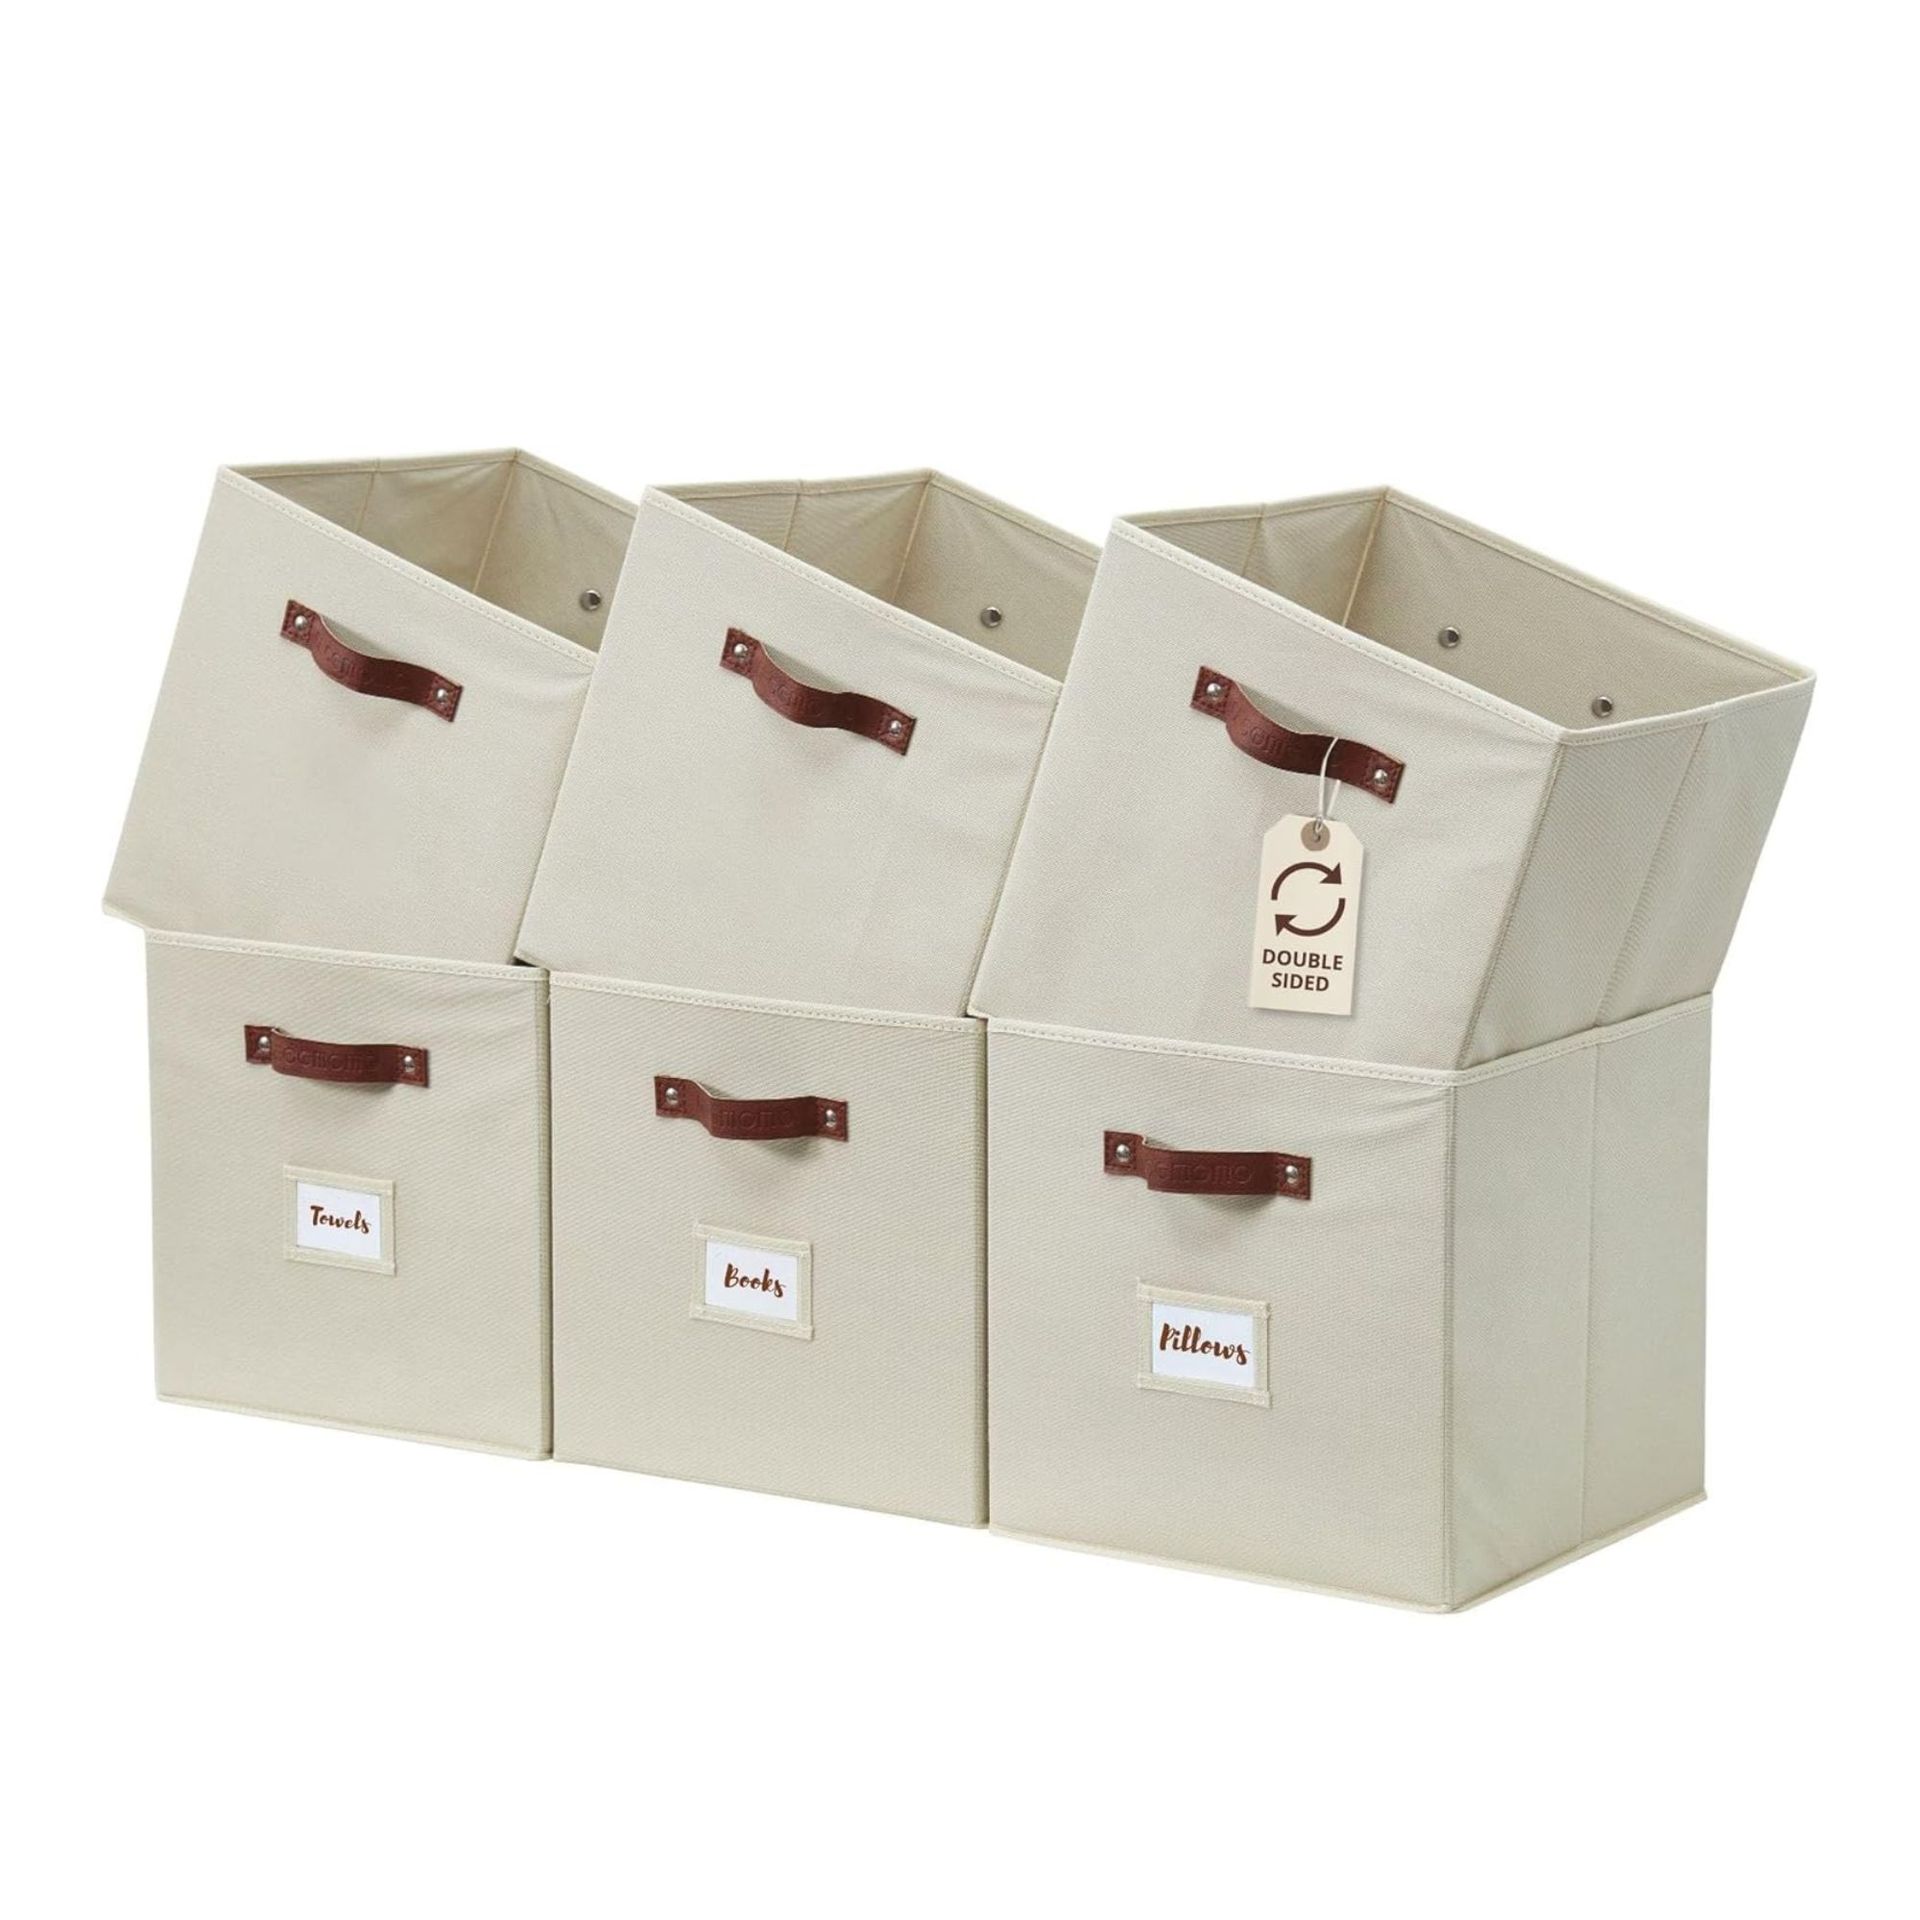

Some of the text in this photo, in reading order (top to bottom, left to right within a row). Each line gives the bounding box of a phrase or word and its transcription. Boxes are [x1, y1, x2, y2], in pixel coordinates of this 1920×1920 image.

[1262, 948, 1344, 971] DOUBLE
[1271, 972, 1330, 992] SIDED
[309, 1205, 371, 1234] Towels
[723, 1262, 787, 1298] Books
[1159, 1322, 1251, 1366] Pillows
